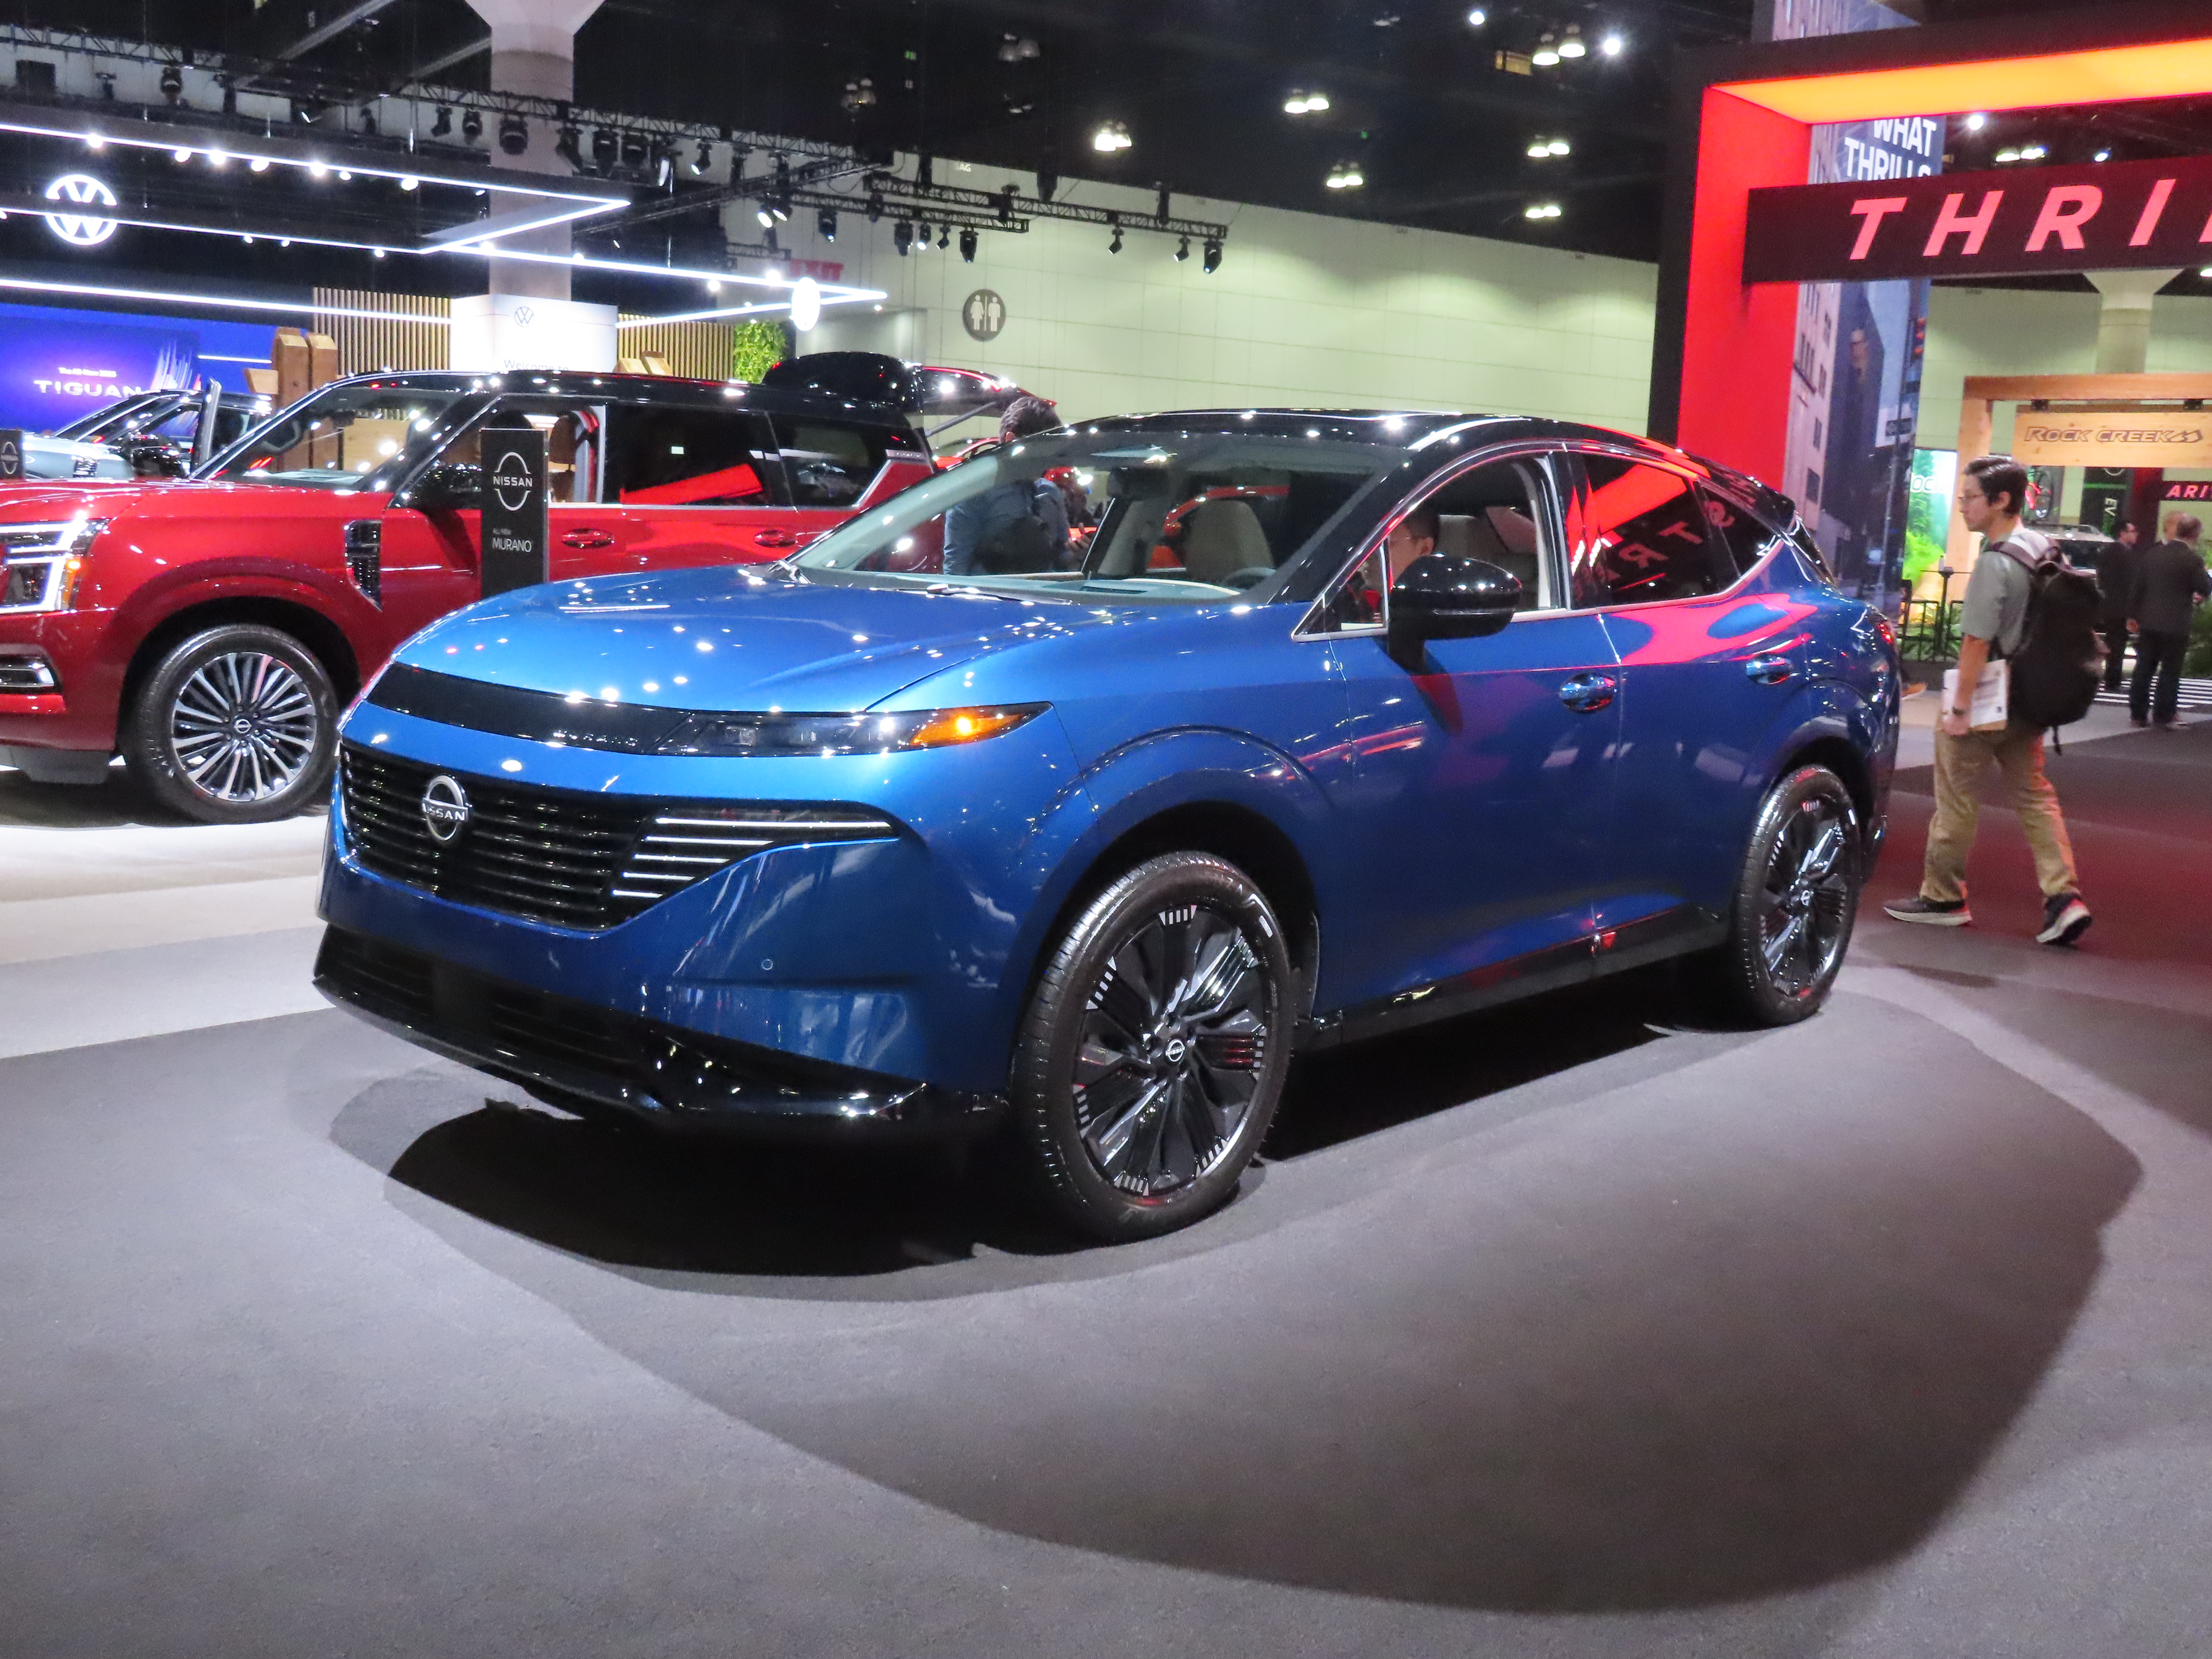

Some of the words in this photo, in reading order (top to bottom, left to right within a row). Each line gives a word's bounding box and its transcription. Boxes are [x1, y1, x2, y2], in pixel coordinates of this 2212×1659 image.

[1874, 116, 1937, 157] WHAT
[1844, 137, 1931, 180] THRI
[1850, 179, 2212, 260] THRI
[504, 359, 554, 370] Welcome
[33, 380, 142, 399] TIGUAN
[2096, 430, 2175, 443] CREEK
[493, 476, 533, 487] NISSAN
[2165, 484, 2212, 498] ARI
[492, 537, 532, 553] MURANO
[1165, 1045, 1186, 1057] NISSAN
